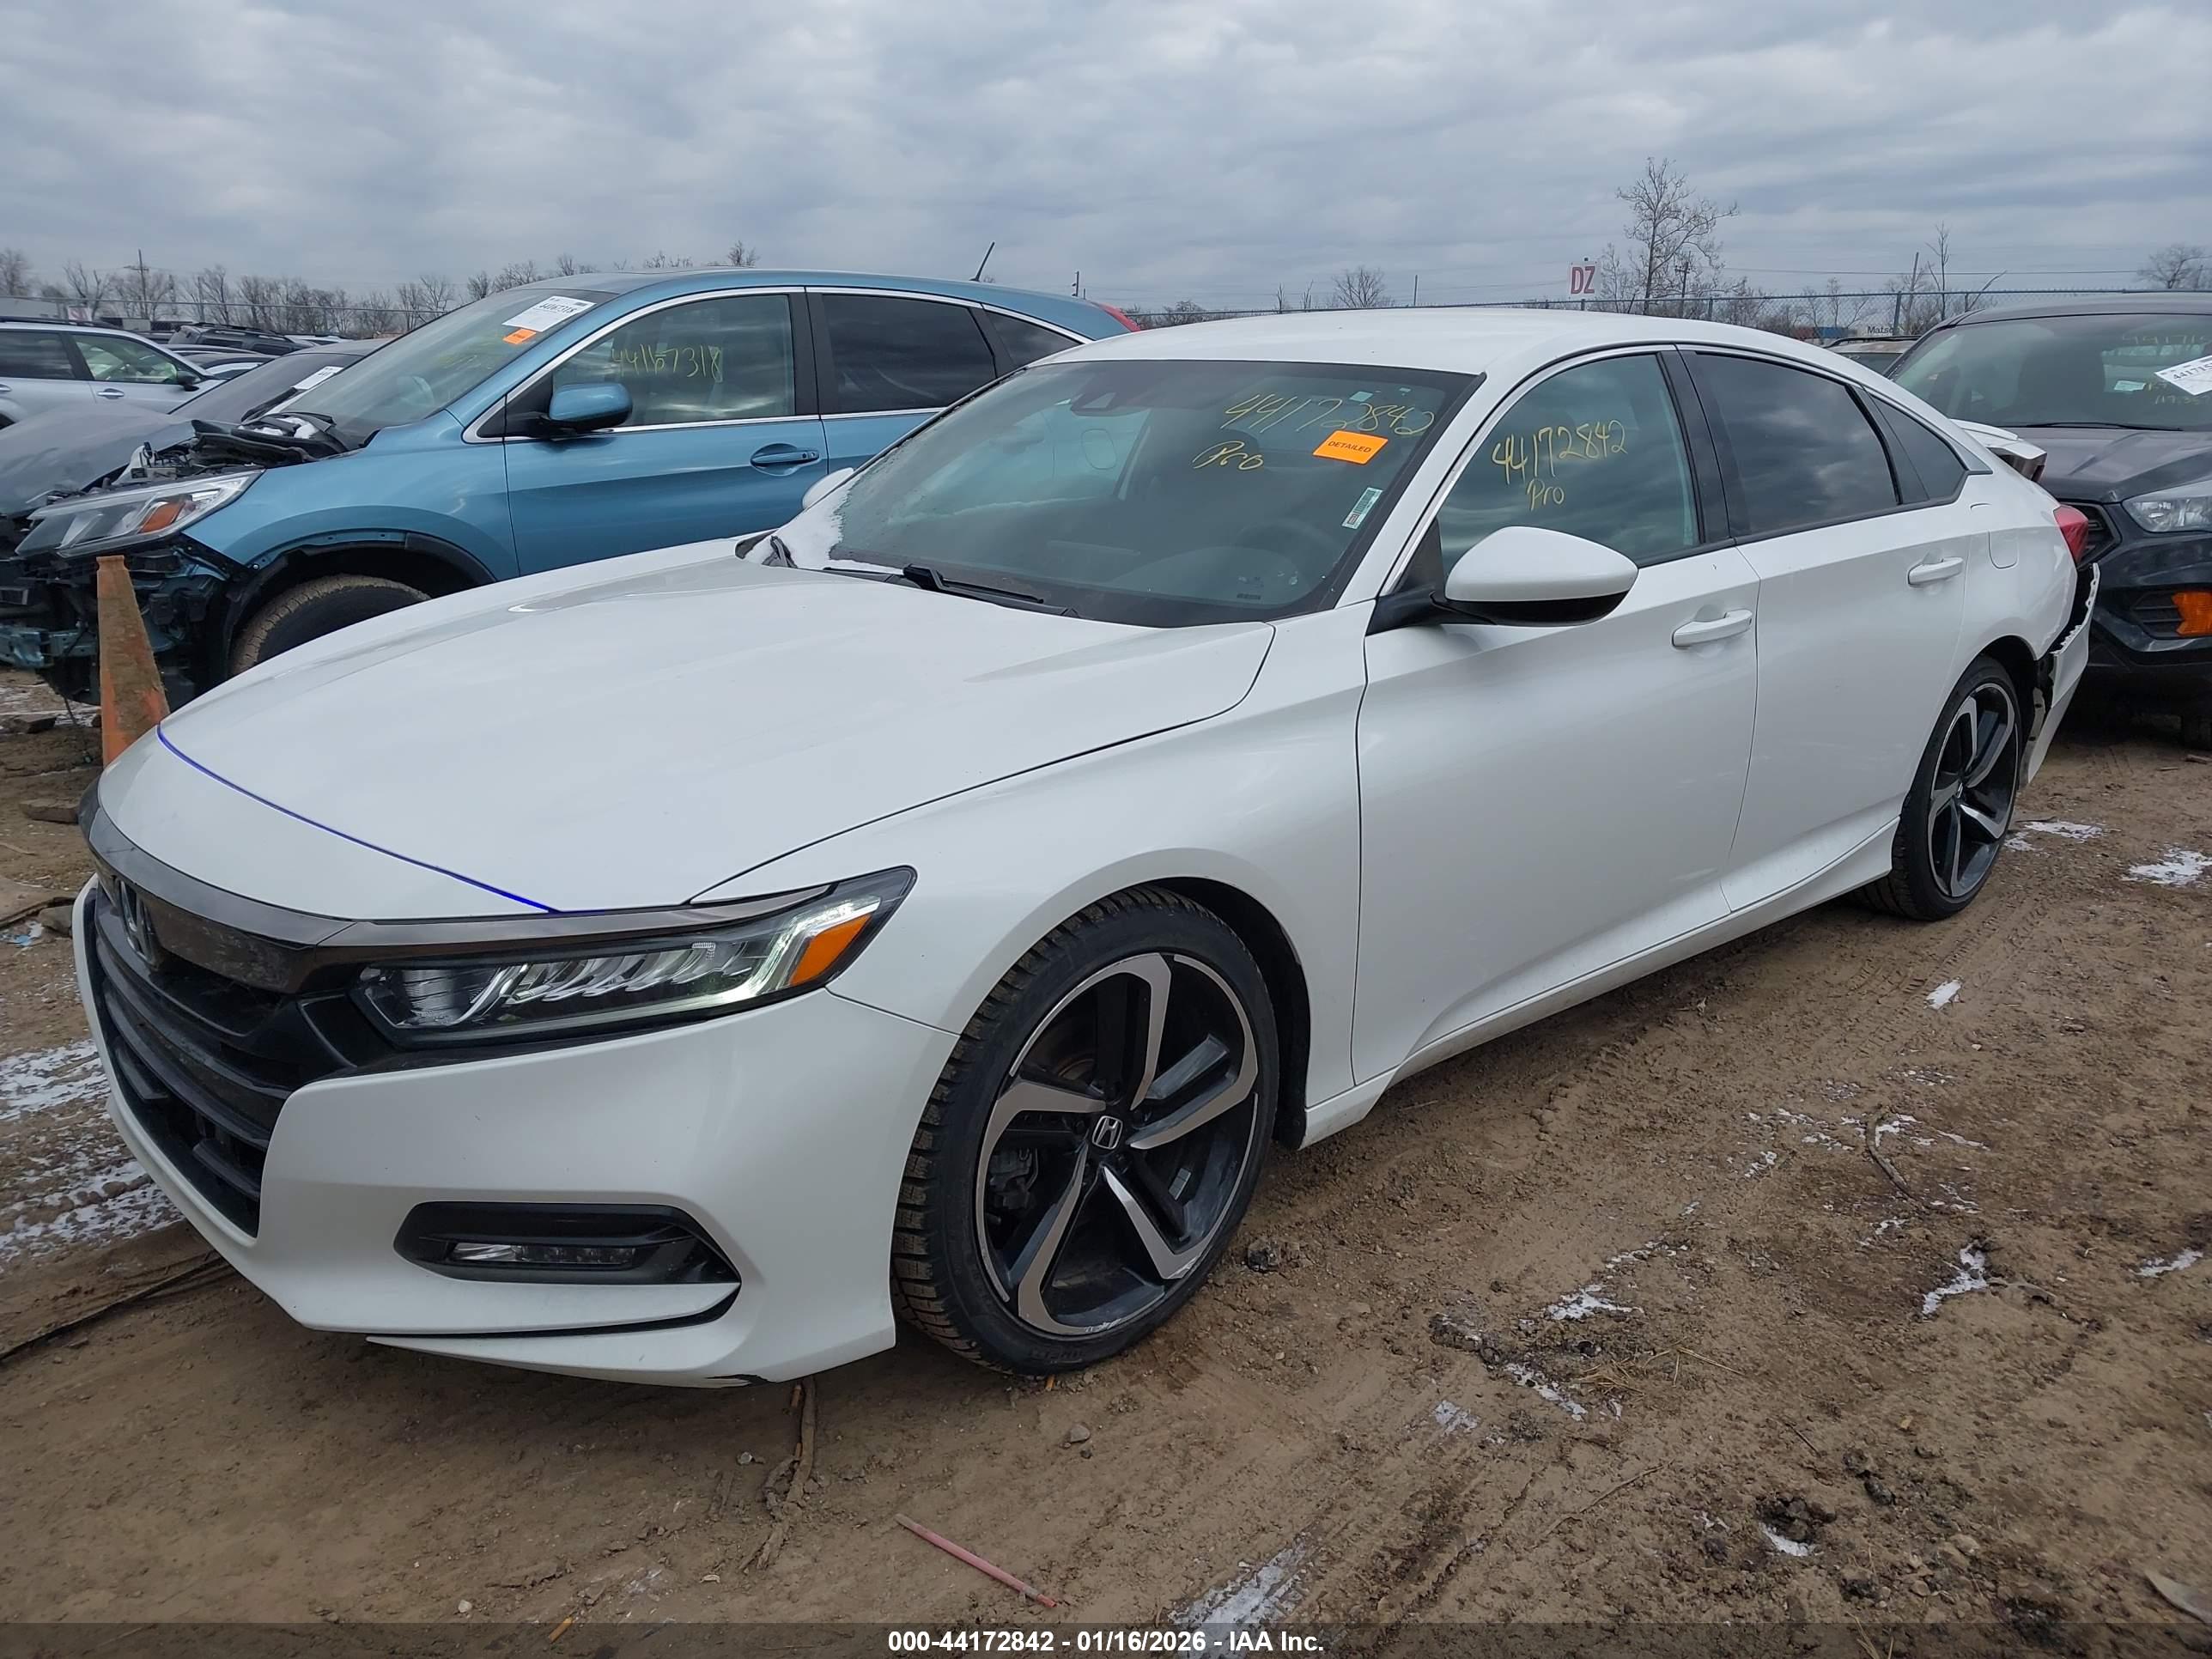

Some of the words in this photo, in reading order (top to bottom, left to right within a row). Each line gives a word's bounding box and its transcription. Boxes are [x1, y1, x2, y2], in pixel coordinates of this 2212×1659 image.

[1571, 265, 1595, 295] DZ
[611, 343, 723, 383] 44167318
[1219, 393, 1435, 435] 44172842
[1328, 441, 1371, 453] DETAILED
[1492, 419, 1628, 485] 44172842
[1527, 478, 1565, 512] Pro
